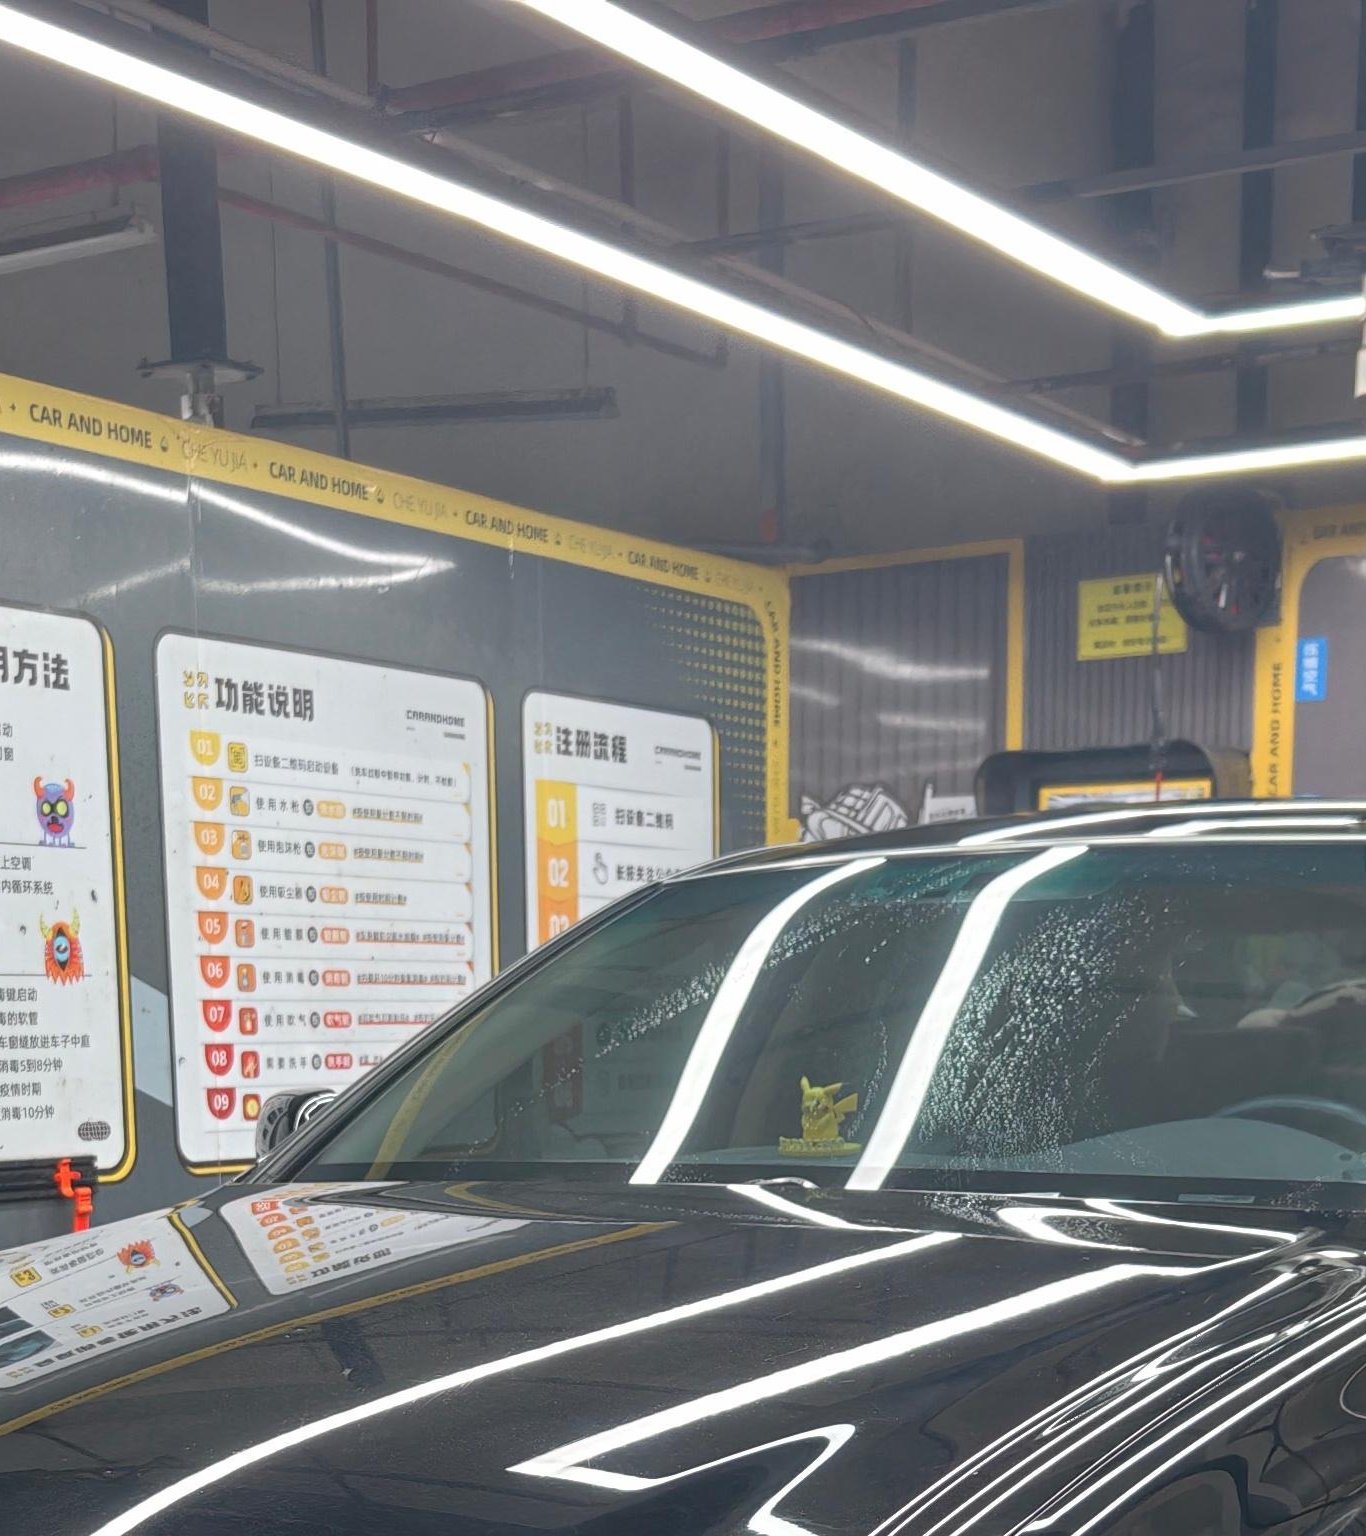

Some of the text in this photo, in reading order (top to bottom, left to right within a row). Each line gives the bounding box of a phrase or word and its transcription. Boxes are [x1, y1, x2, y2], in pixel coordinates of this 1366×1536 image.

[29, 404, 153, 448] CAR AND HOME
[269, 461, 370, 501] CAR AND HOME
[465, 510, 548, 543] CAR AND HOME
[215, 676, 314, 721] 功能说明
[406, 710, 465, 727] CARANDHOME
[197, 739, 212, 755] 01
[556, 726, 627, 764] 注册流程
[199, 784, 215, 800] 02
[548, 800, 566, 828] 01
[200, 829, 217, 845] 03
[203, 874, 220, 890] 04
[548, 859, 569, 888] 02
[205, 918, 221, 935] 05
[207, 962, 223, 979] 06
[209, 1006, 225, 1023] 07
[211, 1050, 227, 1066] 08
[214, 1094, 230, 1110] 09
